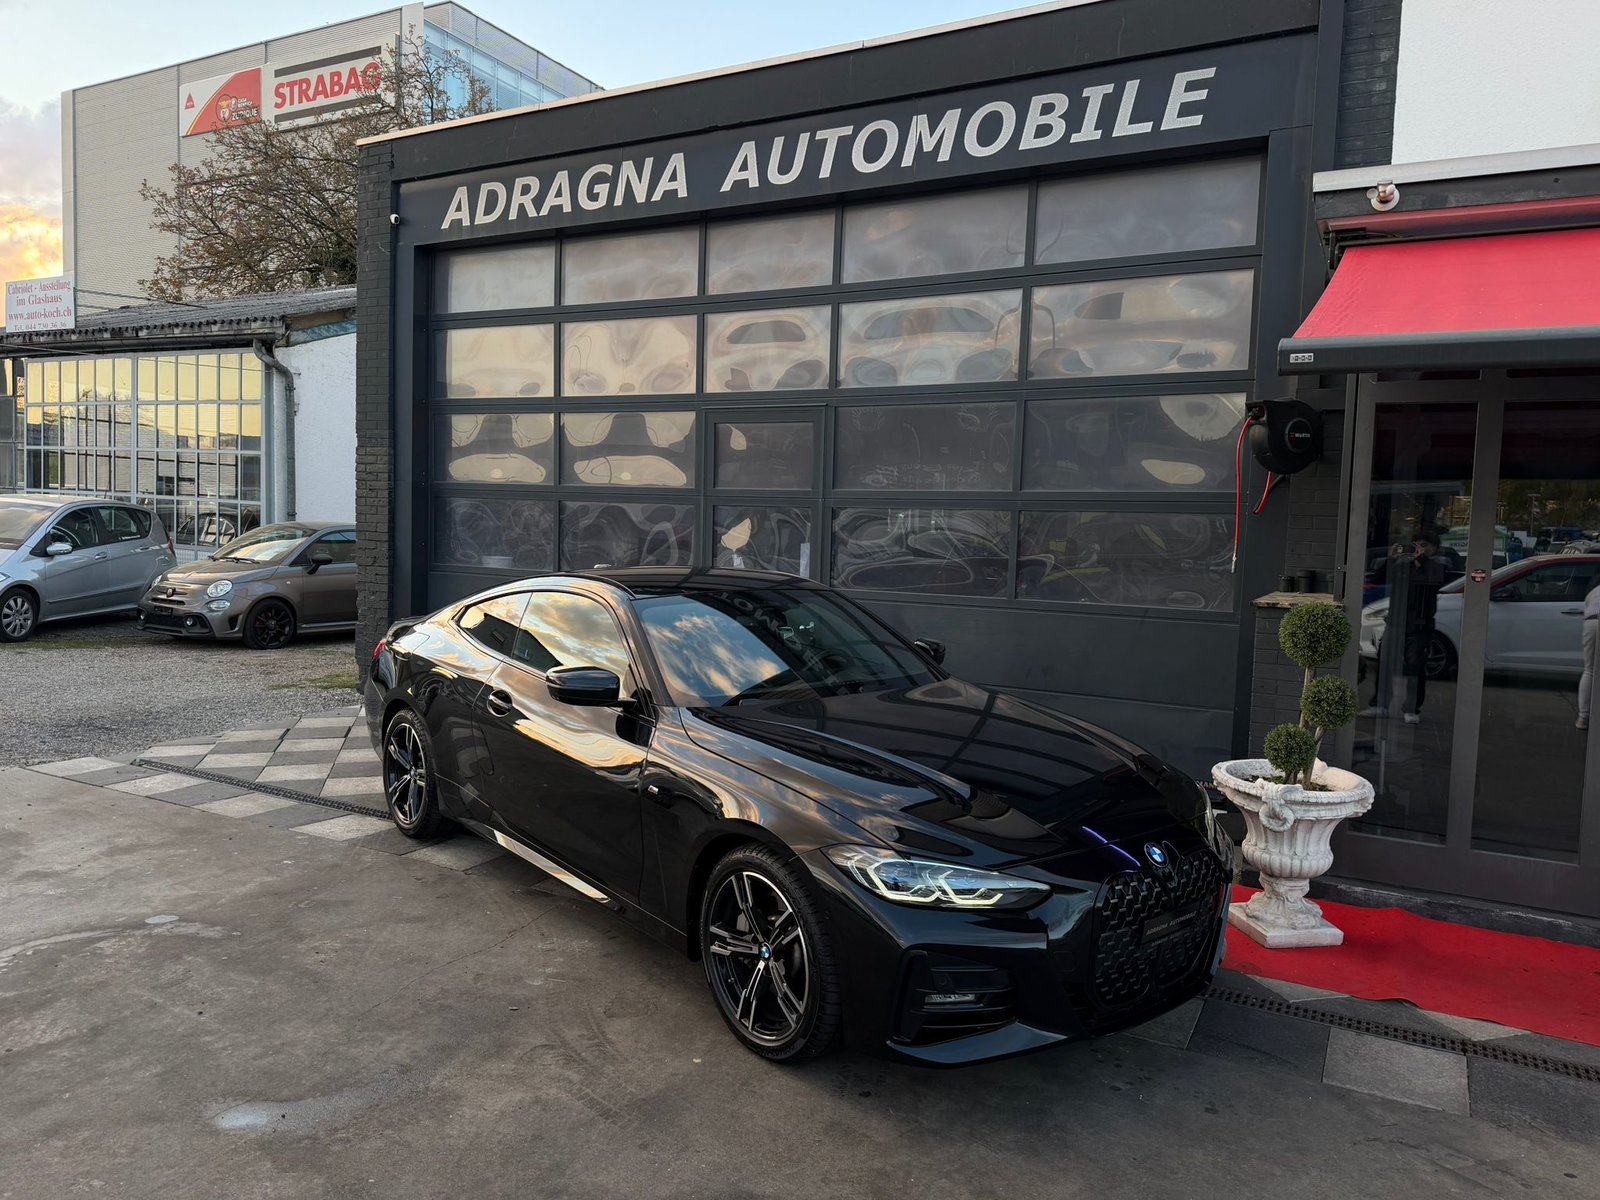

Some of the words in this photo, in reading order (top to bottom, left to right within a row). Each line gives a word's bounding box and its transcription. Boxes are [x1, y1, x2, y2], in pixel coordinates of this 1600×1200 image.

[274, 62, 382, 110] STRABAG
[440, 152, 688, 230] ADRAGNA
[719, 67, 1217, 192] AUTOMOBILE
[39, 280, 71, 292] Ausstellung
[16, 296, 26, 306] im
[28, 293, 63, 305] Glashaus
[8, 306, 72, 320] www.auto-koch.ch
